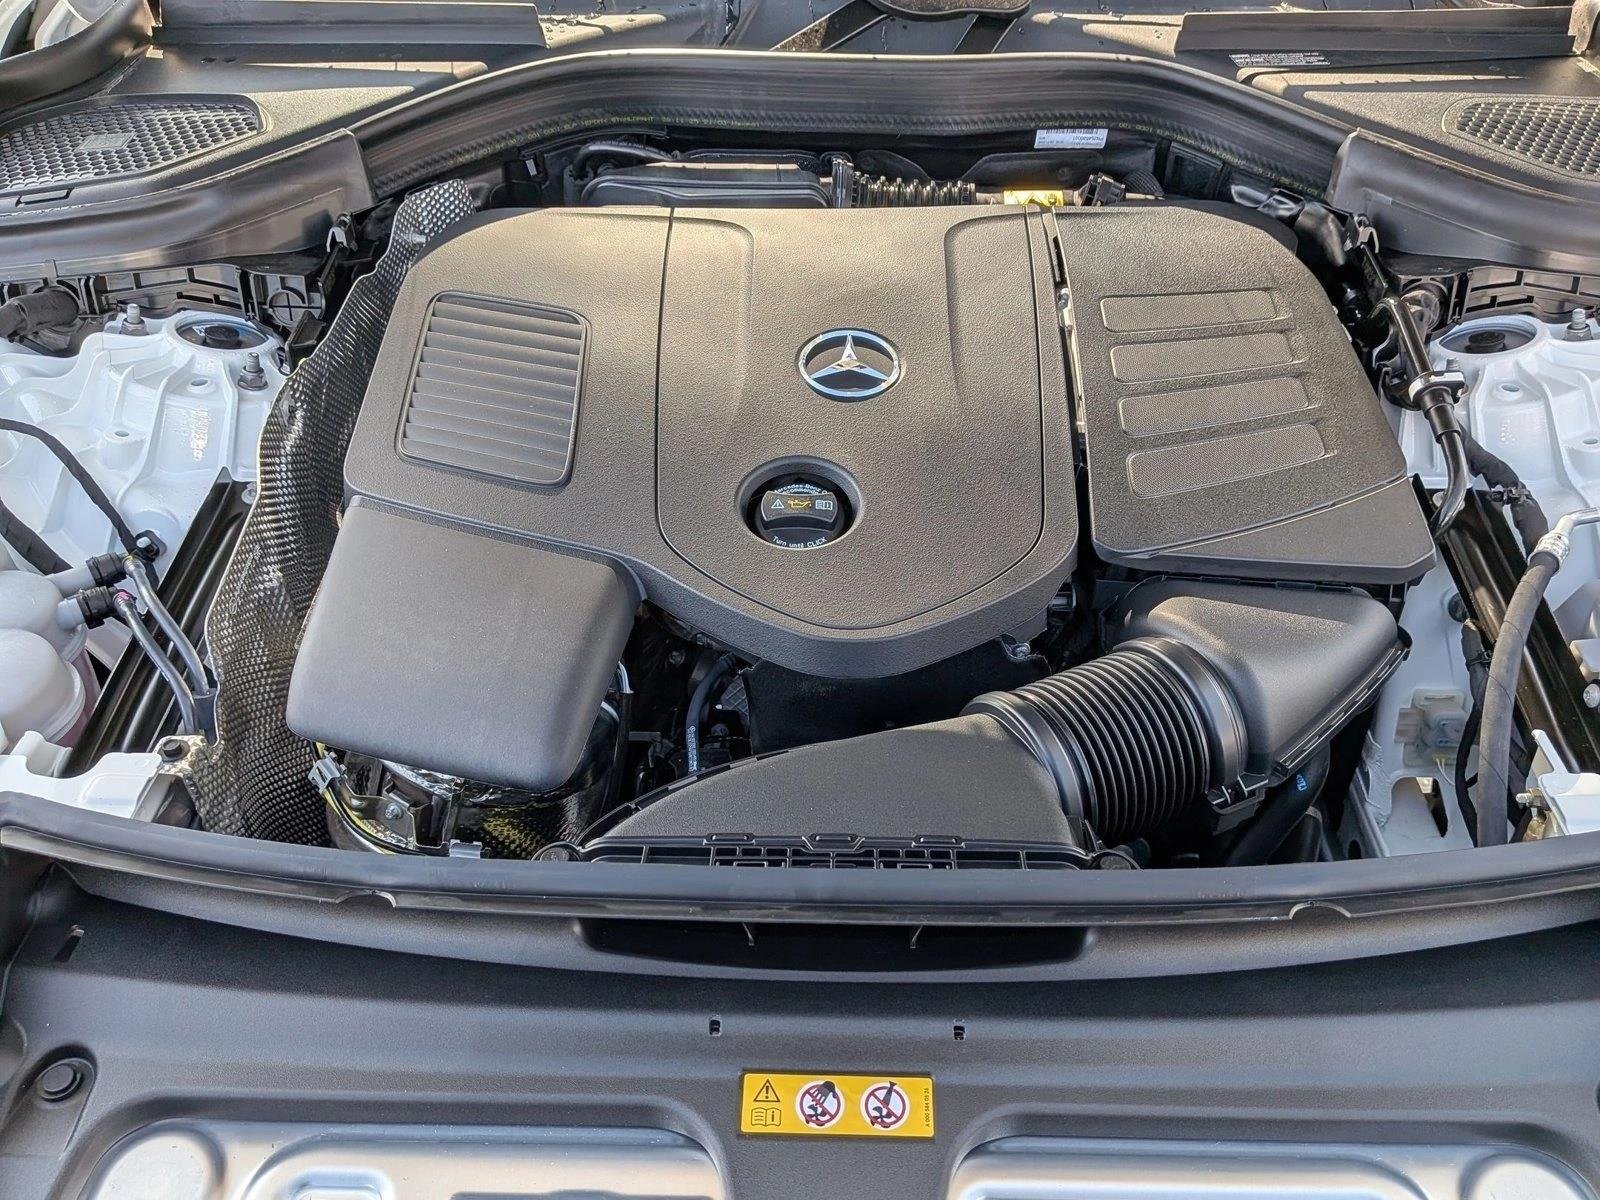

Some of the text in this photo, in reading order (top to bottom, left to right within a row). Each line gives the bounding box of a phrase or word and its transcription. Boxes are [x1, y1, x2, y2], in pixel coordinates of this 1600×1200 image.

[774, 483, 821, 494] ercedes-Benz
[772, 535, 787, 547] Turn
[807, 536, 827, 548] CLICK
